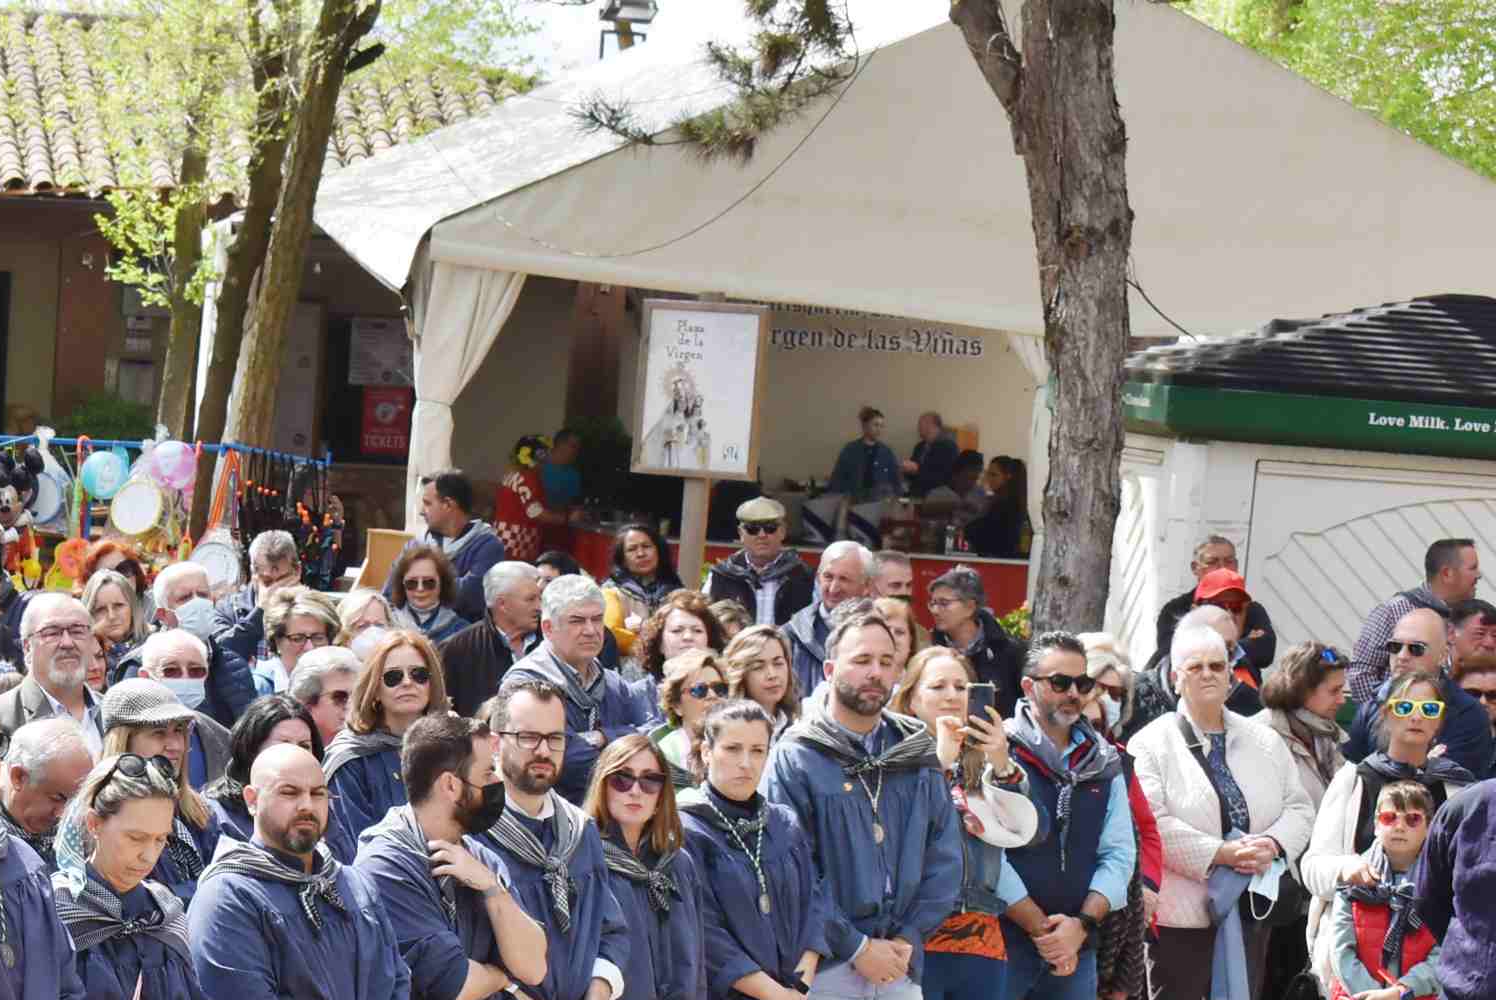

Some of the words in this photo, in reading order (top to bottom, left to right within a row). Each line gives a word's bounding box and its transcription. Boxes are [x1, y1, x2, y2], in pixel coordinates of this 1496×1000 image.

[770, 327, 824, 349] rgen
[832, 327, 857, 349] de
[866, 328, 902, 351] las
[911, 329, 983, 356] Viñas
[1368, 412, 1405, 426] Love
[1409, 415, 1449, 430] Milk.
[1454, 417, 1491, 432] Love
